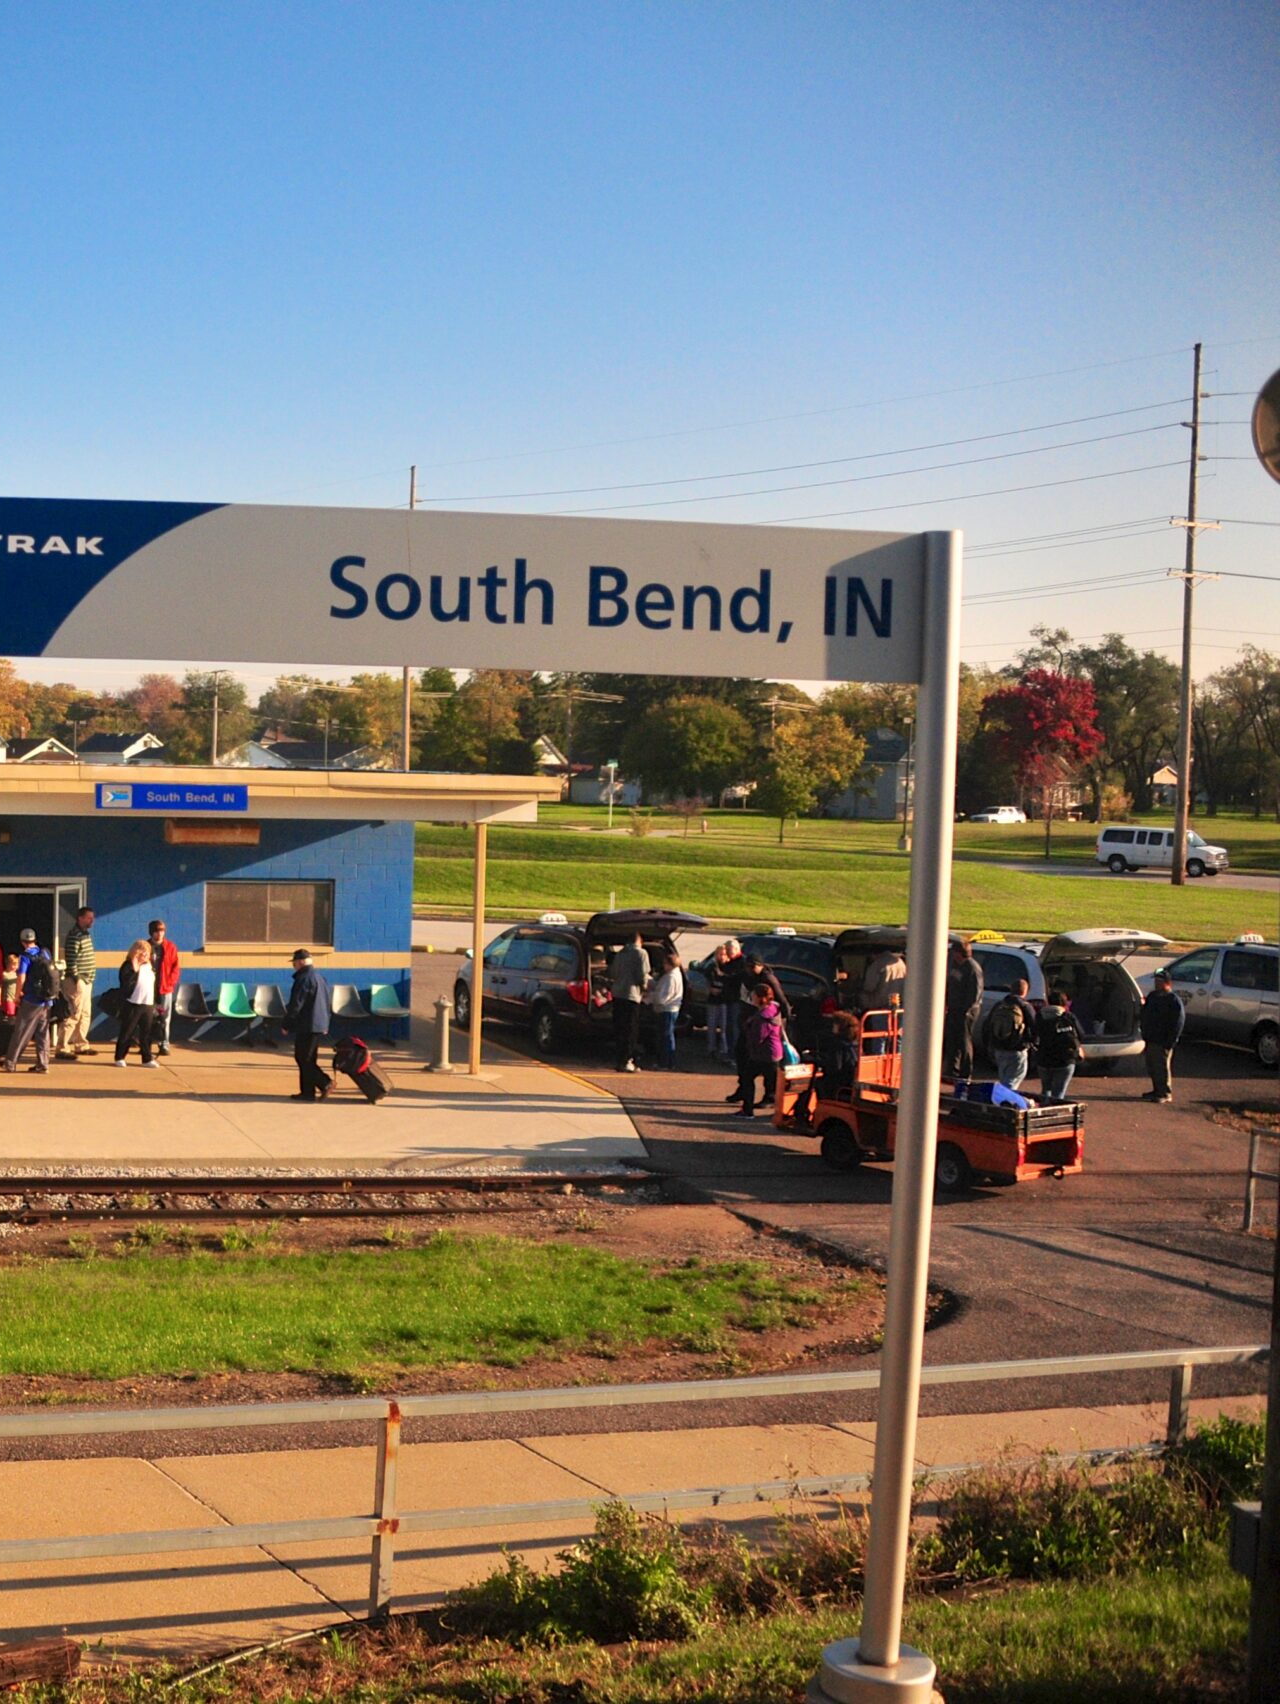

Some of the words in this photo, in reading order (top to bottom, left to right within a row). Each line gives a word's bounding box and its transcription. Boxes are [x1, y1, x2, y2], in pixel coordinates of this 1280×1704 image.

[328, 554, 556, 626] South
[587, 565, 794, 644] Bend,
[823, 575, 894, 638] IN
[146, 791, 181, 802] South
[185, 792, 218, 804] Bend,
[222, 793, 235, 803] IN
